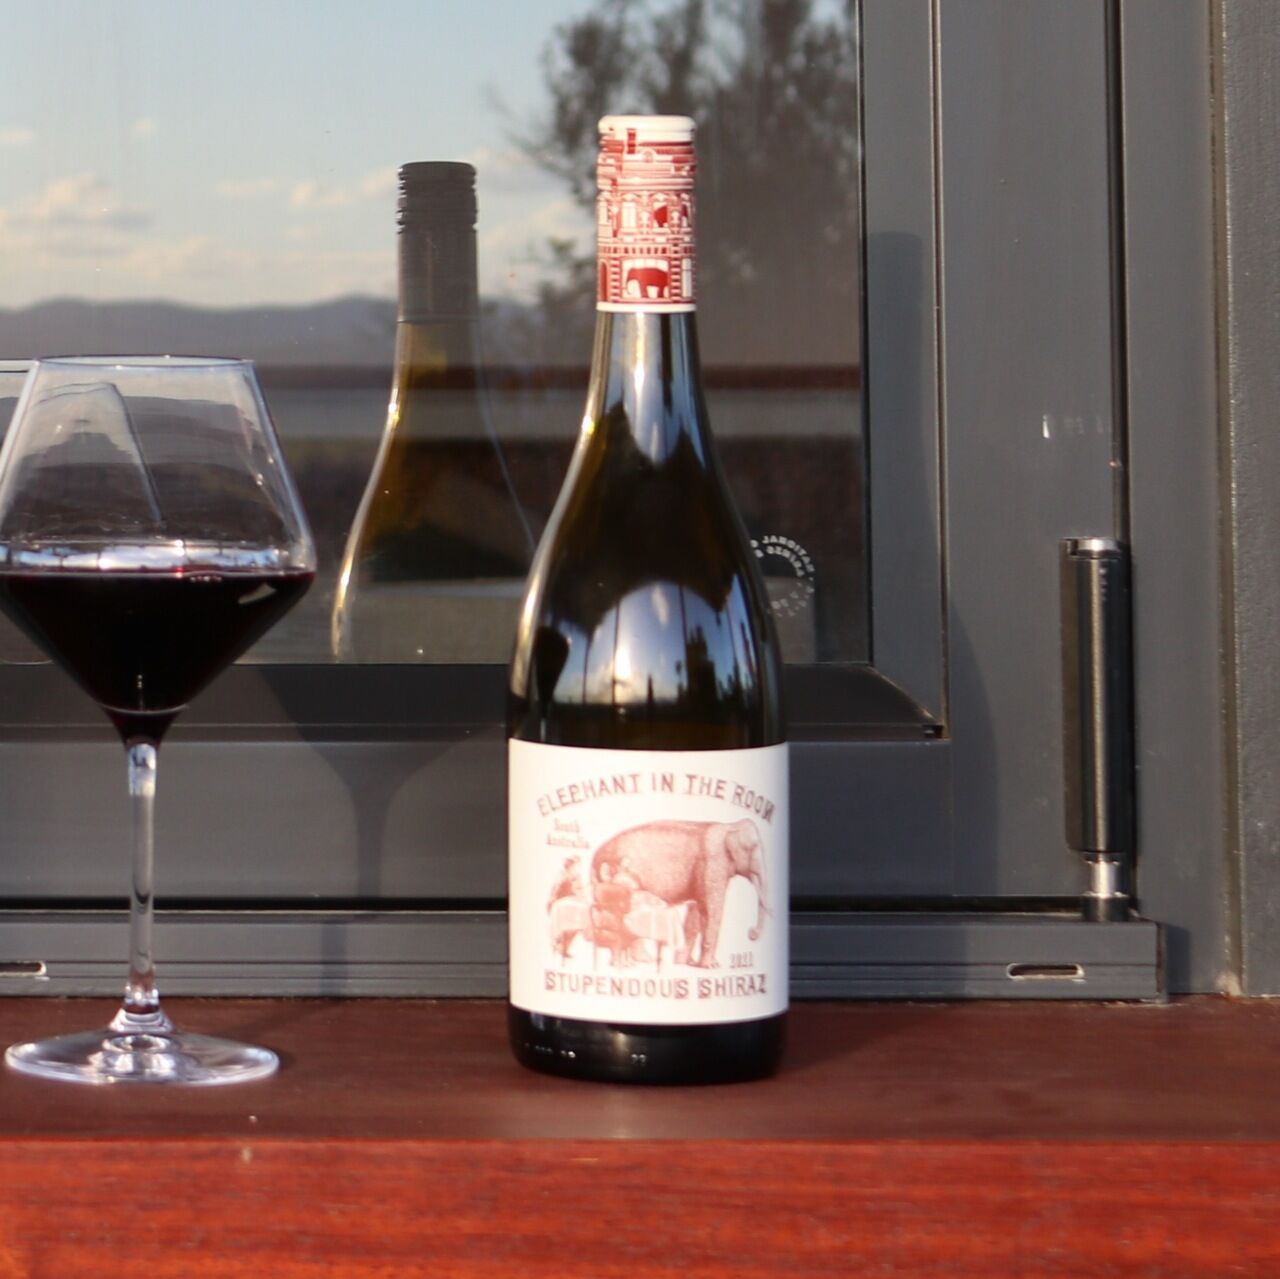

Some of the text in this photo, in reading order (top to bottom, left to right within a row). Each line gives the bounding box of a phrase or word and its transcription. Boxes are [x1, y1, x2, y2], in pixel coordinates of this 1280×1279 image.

[536, 773, 777, 825] ELEPHANT IN THE ROOM
[544, 969, 768, 1000] STUPENDOUS SHIRAZ
